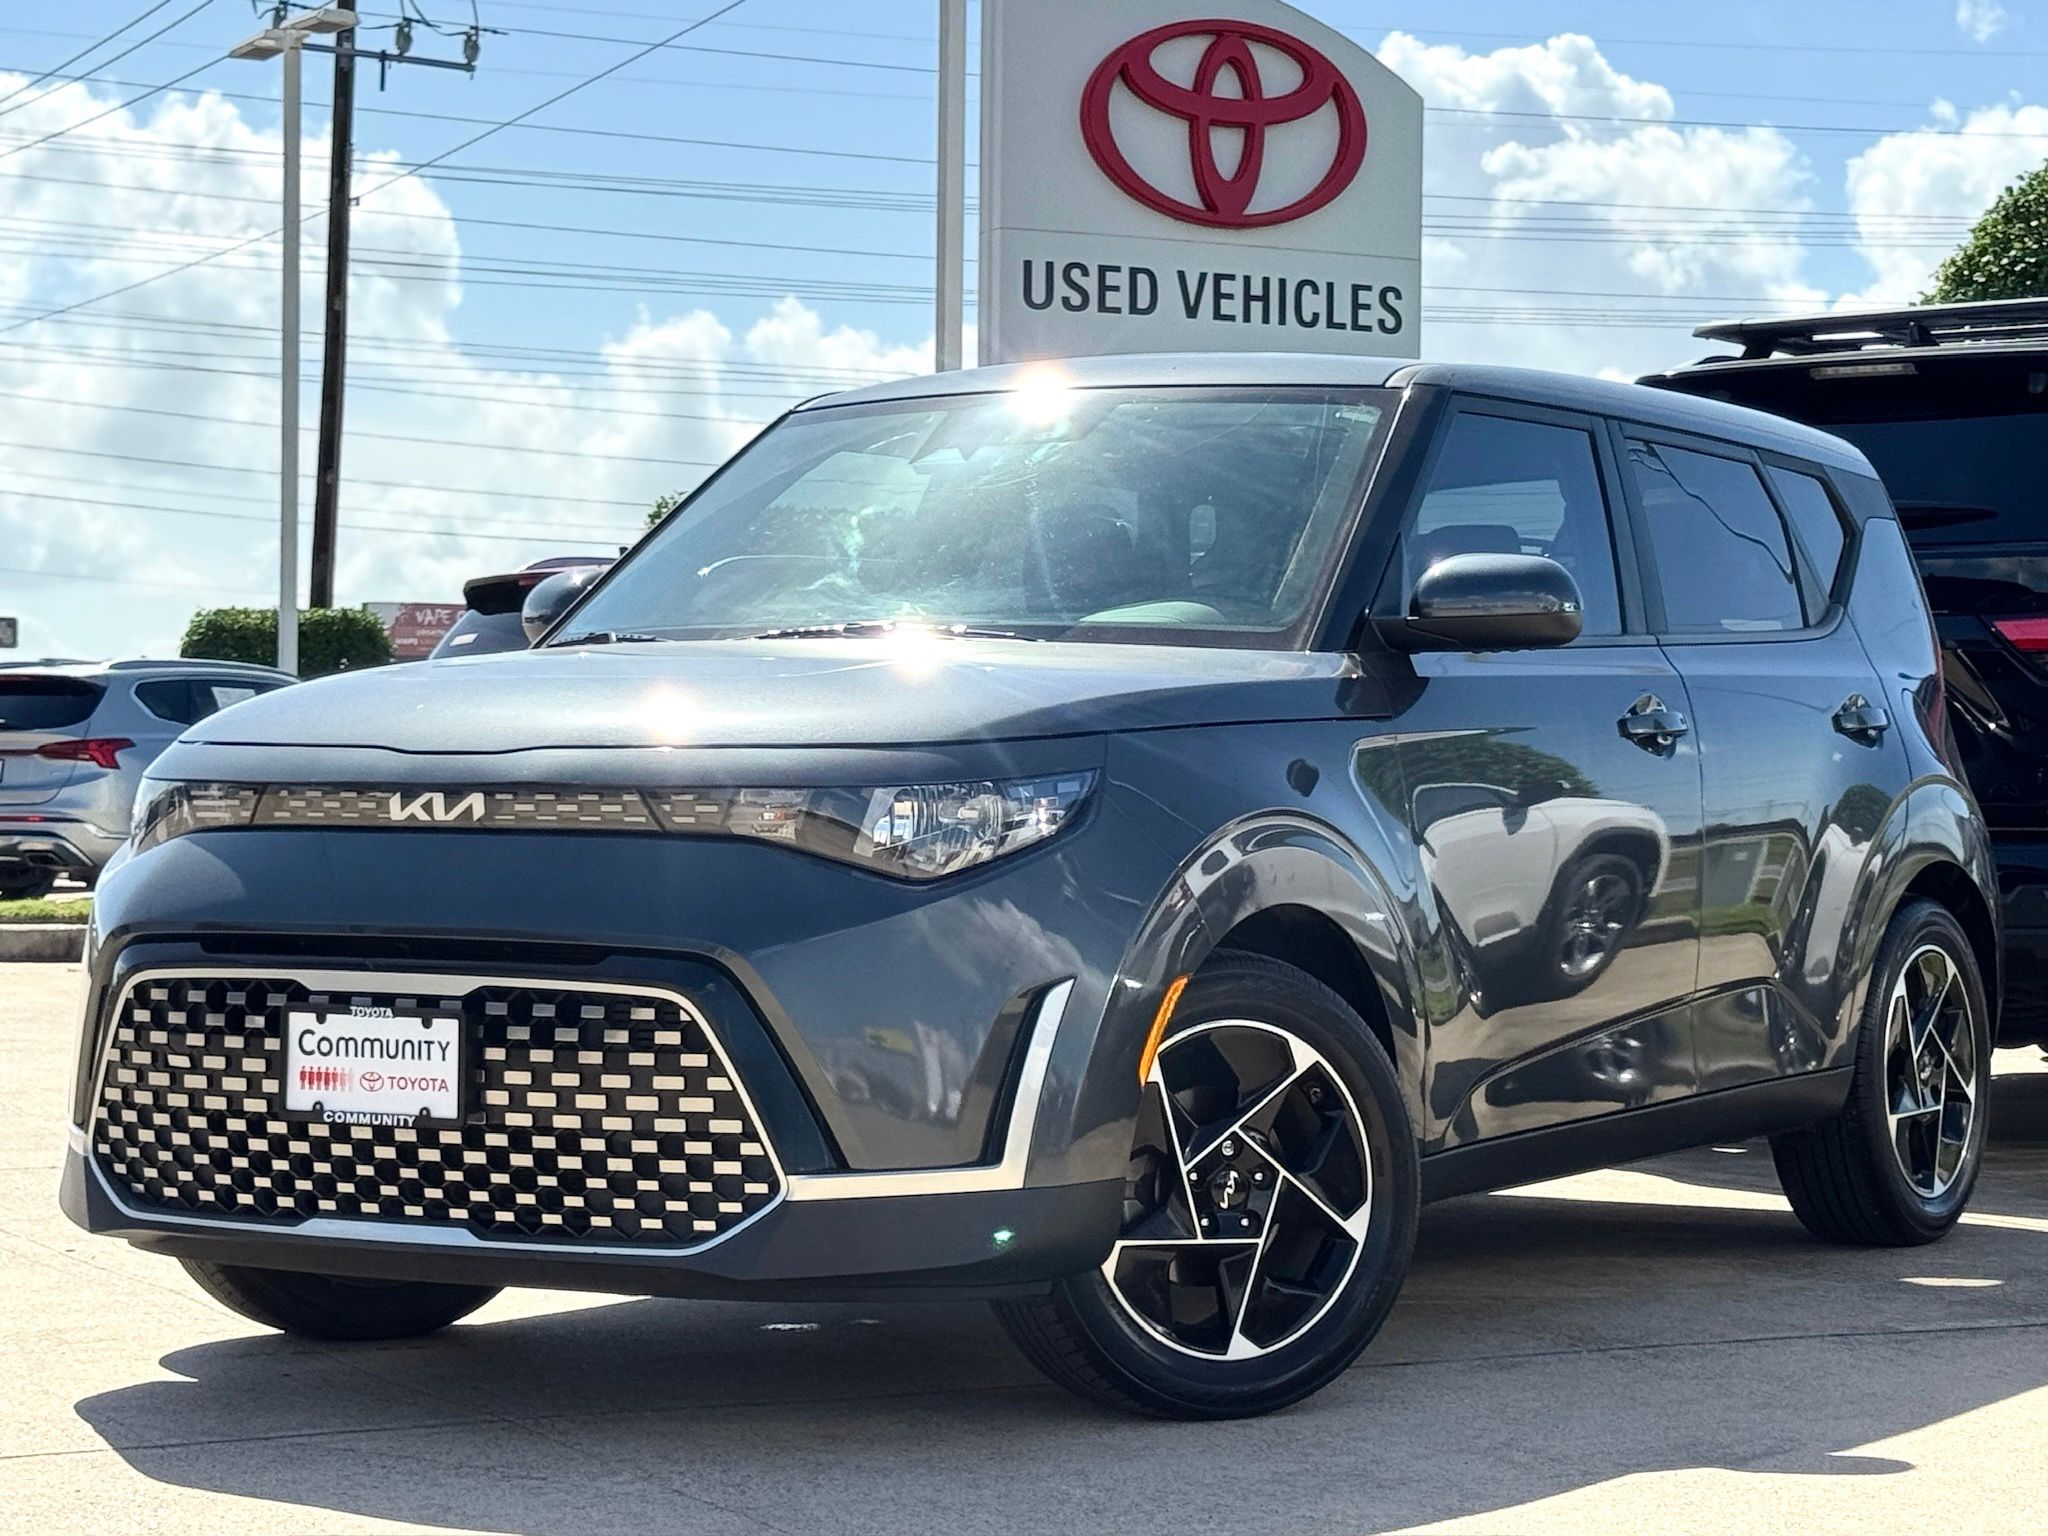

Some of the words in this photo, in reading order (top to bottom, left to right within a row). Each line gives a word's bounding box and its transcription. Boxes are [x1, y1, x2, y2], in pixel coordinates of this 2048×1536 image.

[1022, 259, 1159, 318] USED
[1176, 269, 1404, 336] VEHICLES
[415, 608, 452, 625] VAPE
[389, 792, 486, 821] KIA
[350, 1006, 394, 1018] TOYOTA
[388, 1075, 449, 1093] TOYOTA
[323, 1110, 417, 1127] COMMUNITY
